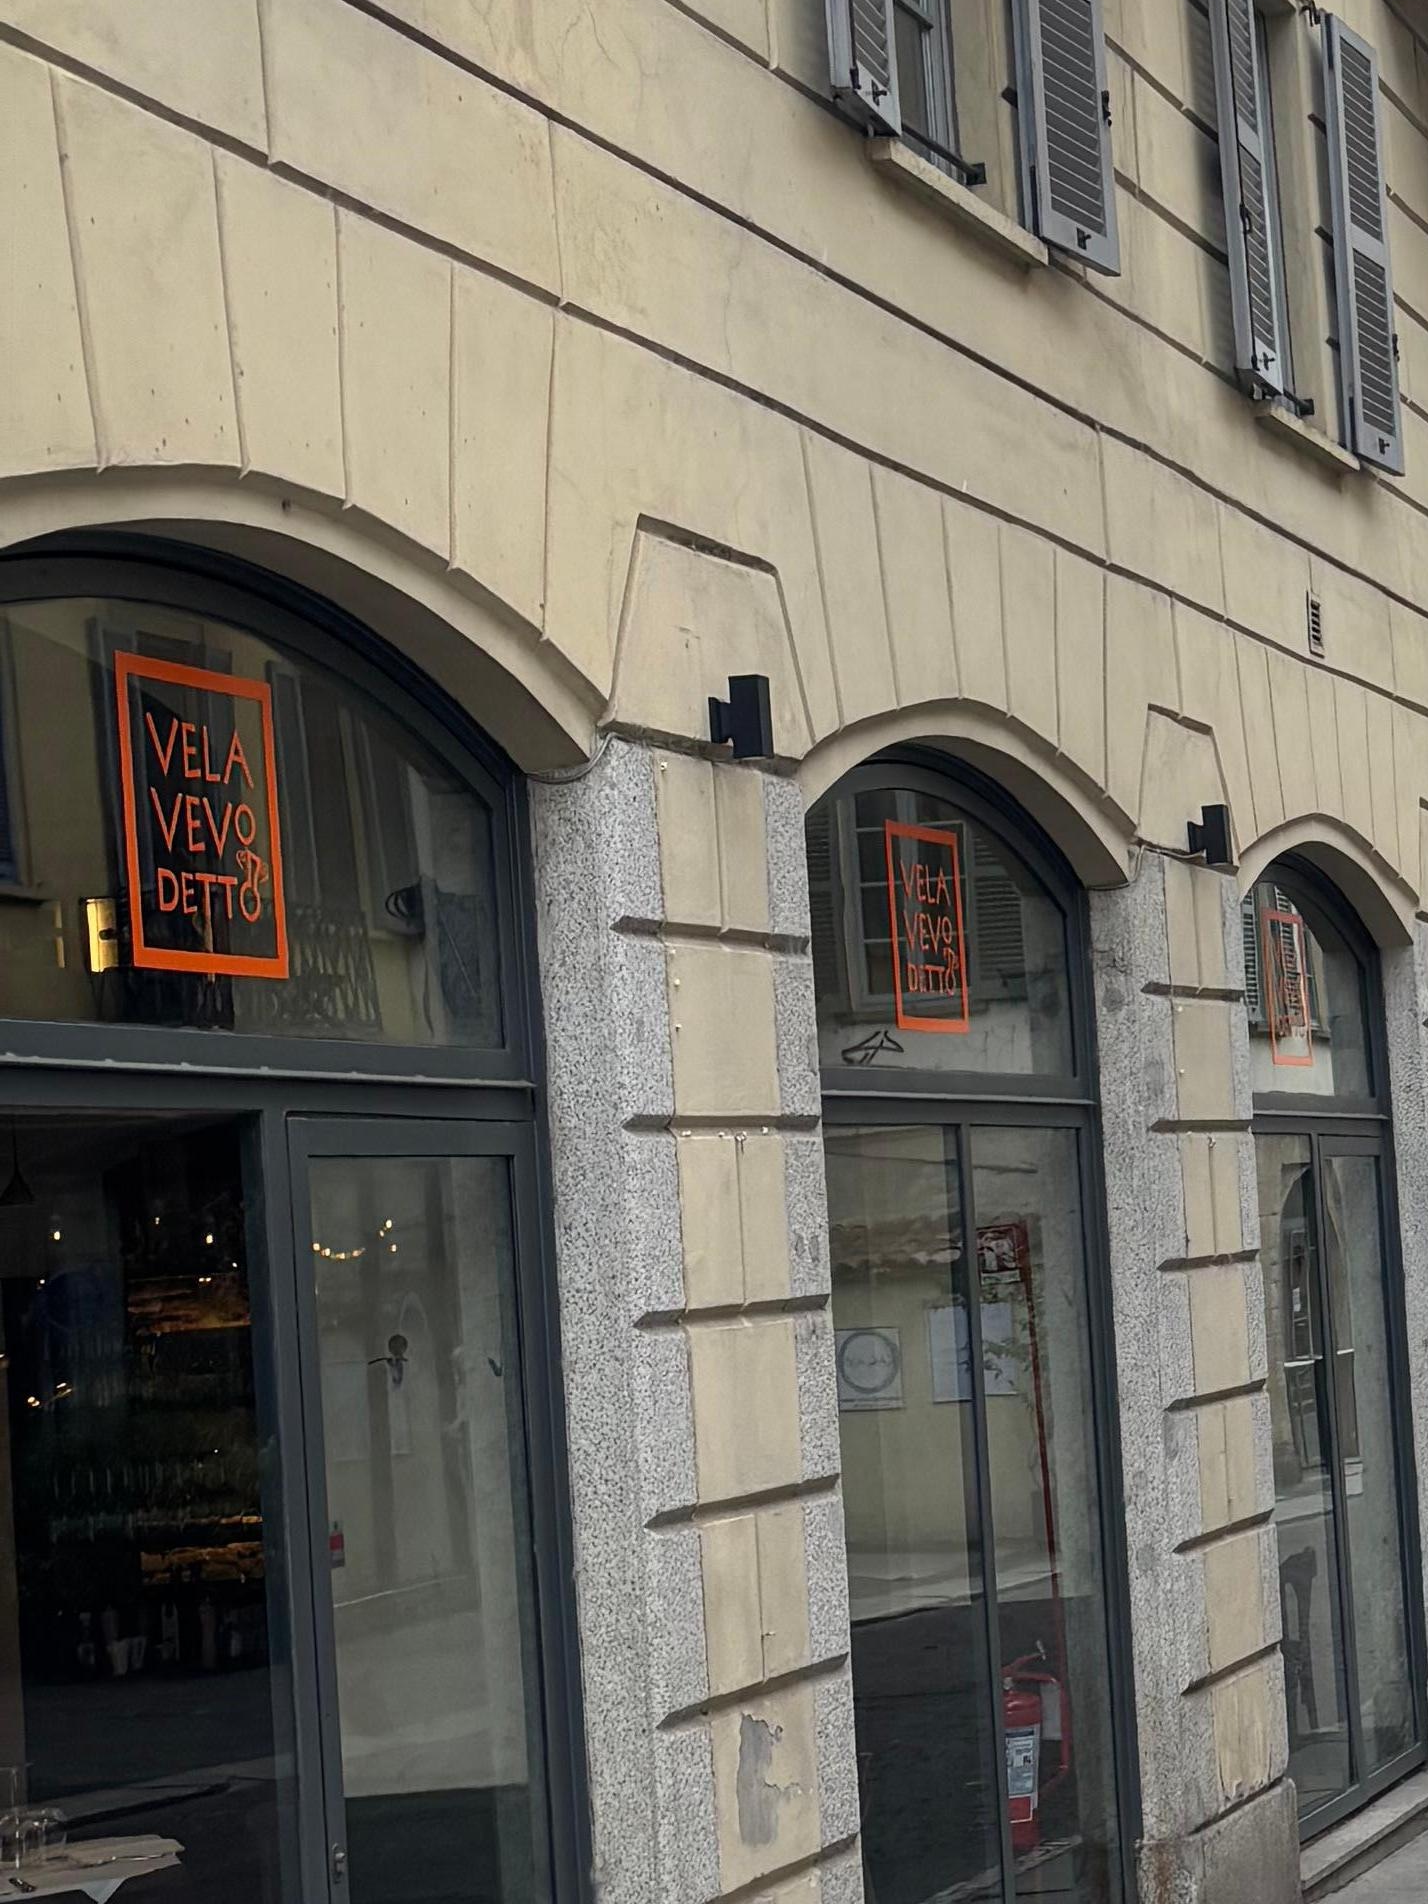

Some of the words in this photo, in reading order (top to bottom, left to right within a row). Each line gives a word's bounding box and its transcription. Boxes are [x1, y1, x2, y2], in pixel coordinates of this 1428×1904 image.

[146, 712, 253, 789] VELA
[150, 786, 257, 859] VEVO
[157, 867, 261, 923] DETTO
[899, 859, 950, 906] VELA
[903, 909, 953, 953] VEVO
[907, 961, 957, 997] DETTO
